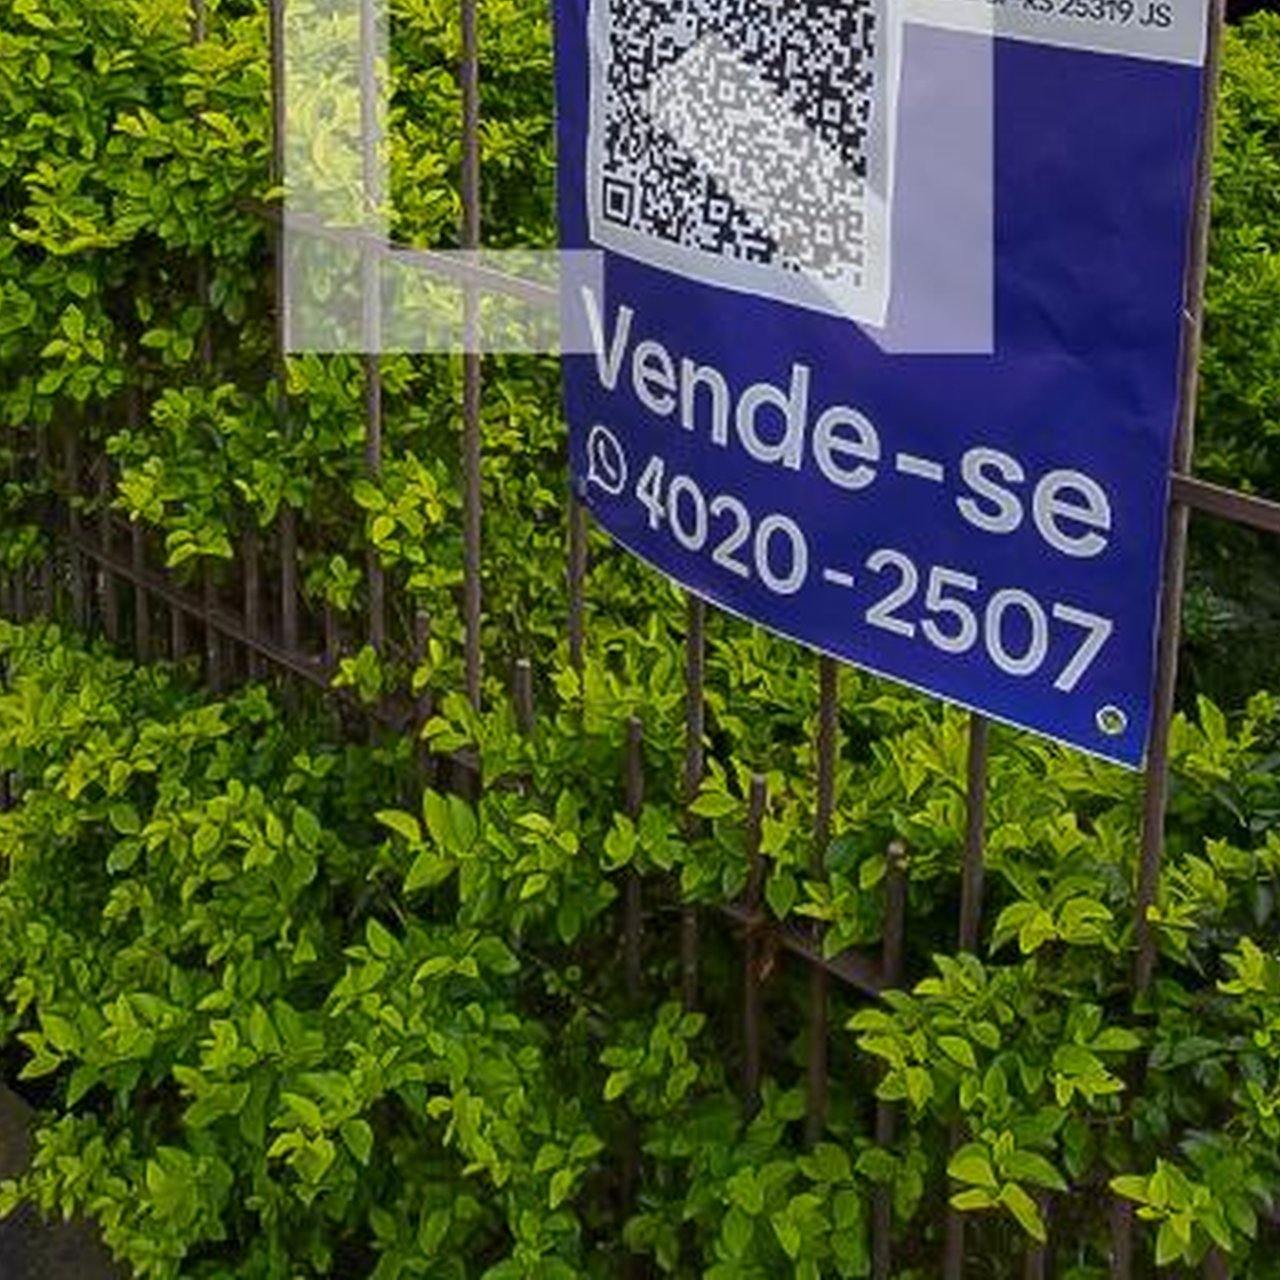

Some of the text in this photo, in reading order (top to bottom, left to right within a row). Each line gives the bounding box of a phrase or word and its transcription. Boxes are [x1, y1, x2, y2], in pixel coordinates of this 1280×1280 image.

[1139, 2, 1172, 28] JS
[581, 285, 1113, 557] Vende-se
[636, 456, 1113, 693] 4020-2507
